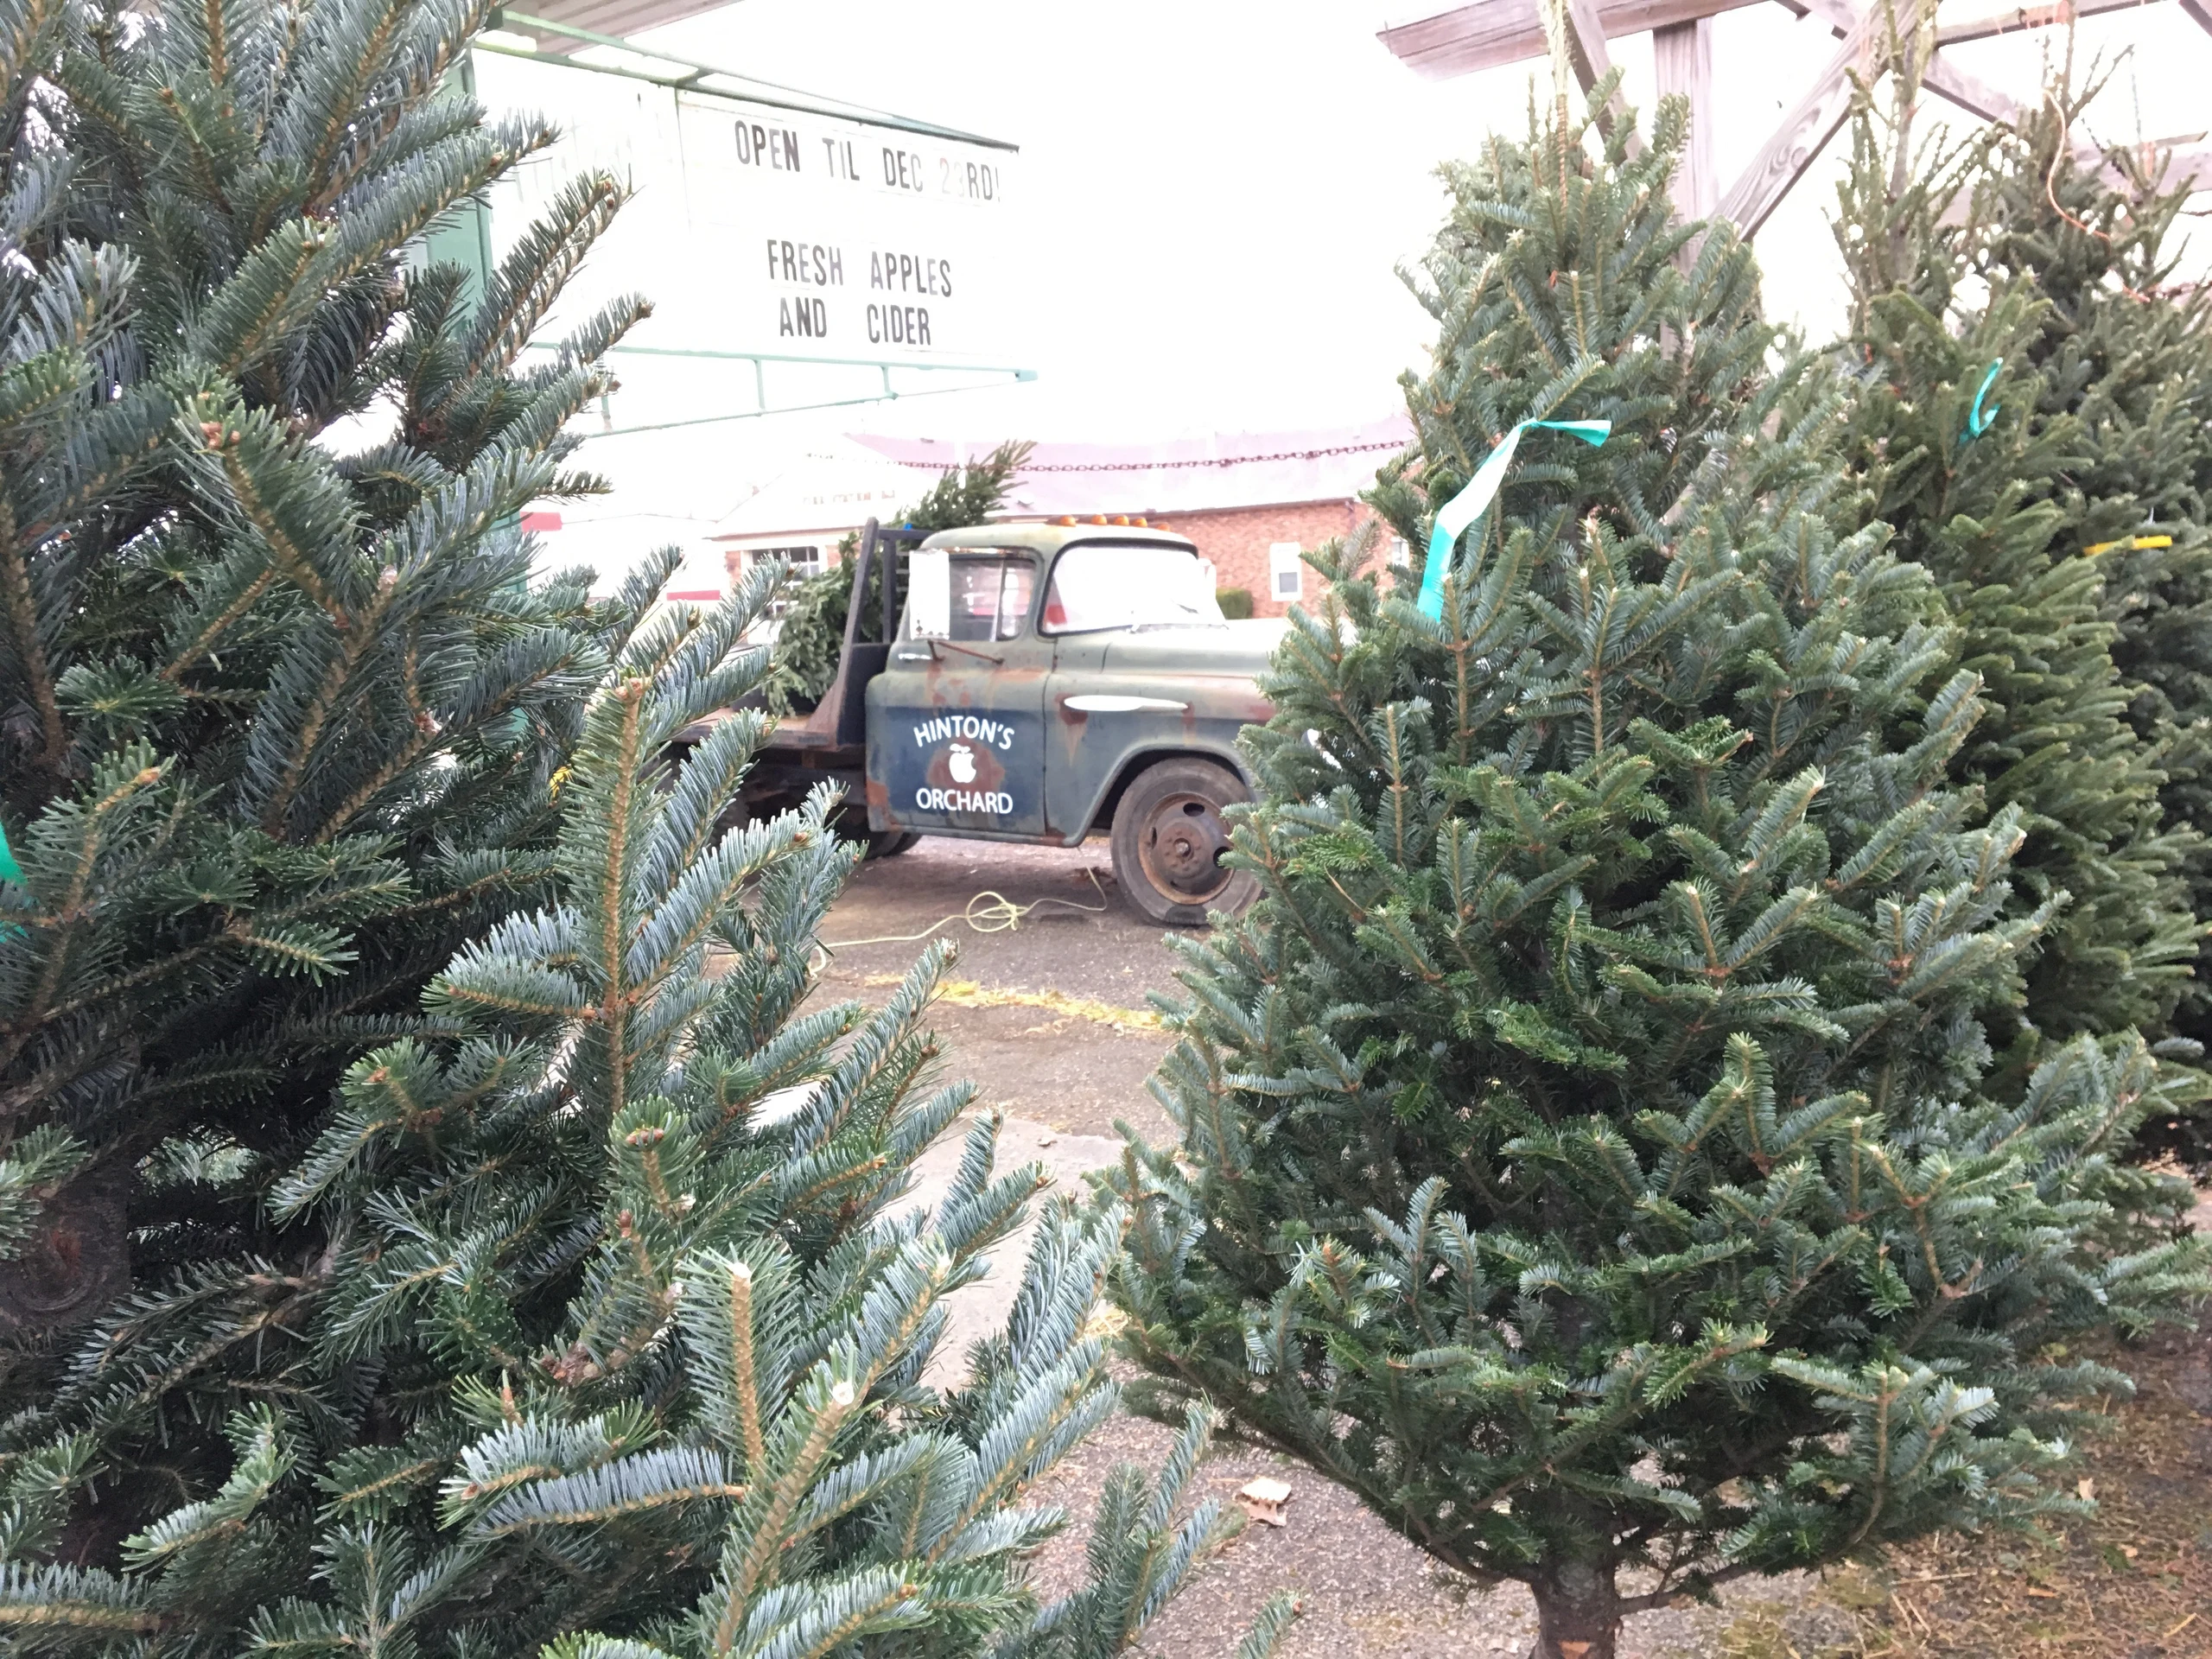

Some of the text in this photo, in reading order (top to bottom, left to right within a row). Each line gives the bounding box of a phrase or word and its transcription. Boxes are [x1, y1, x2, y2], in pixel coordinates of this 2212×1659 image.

[734, 119, 1001, 203] OPEN TIL DEC 23RD!
[767, 238, 952, 298] FRESH APPLES
[779, 296, 931, 346] AND CIDER
[913, 715, 1015, 750] HINTON'S
[916, 787, 1014, 814] ORCHARD
